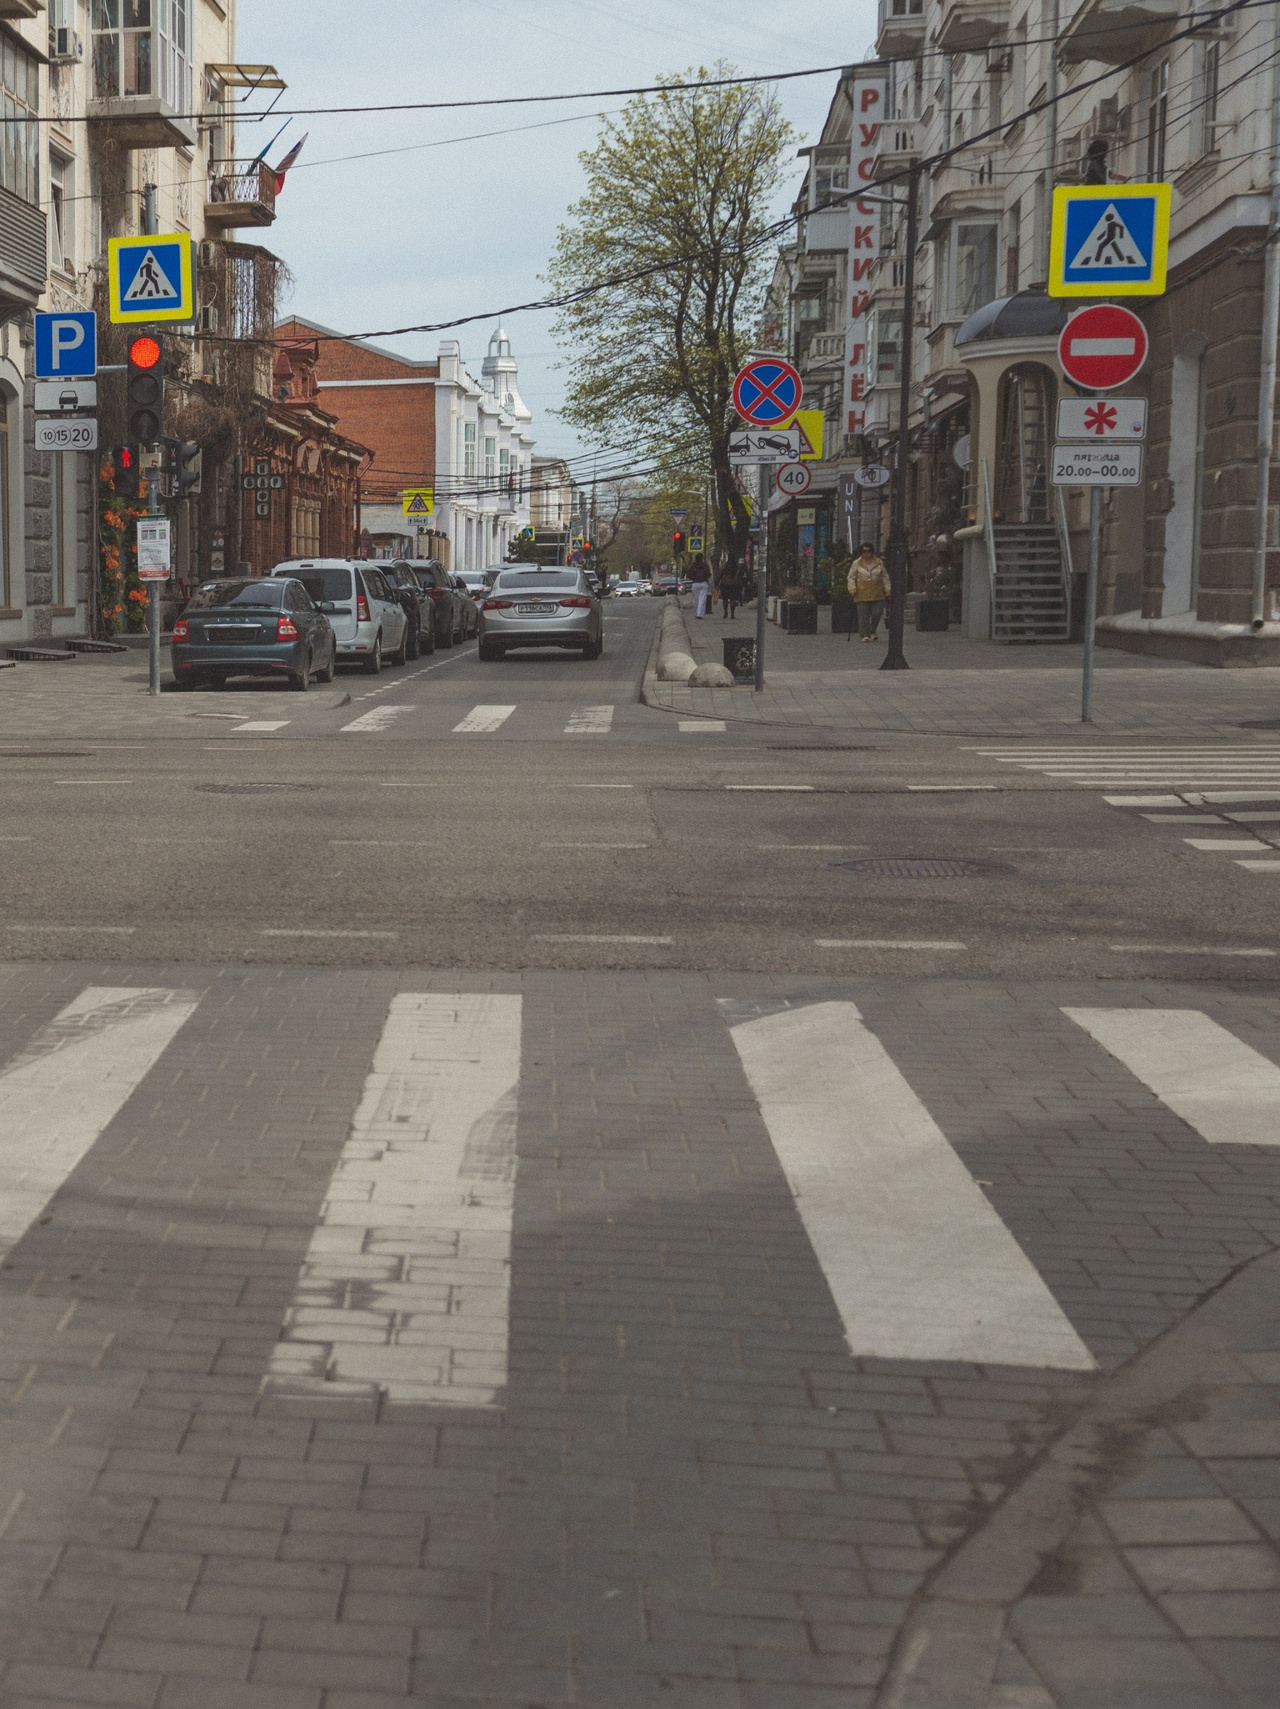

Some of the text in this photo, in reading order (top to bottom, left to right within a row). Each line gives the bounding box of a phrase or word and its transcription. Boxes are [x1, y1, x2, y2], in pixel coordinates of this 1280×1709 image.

[847, 88, 880, 433] РУССКИЙ ЛЁН
[51, 319, 85, 370] P
[43, 428, 90, 442] 10 15 20
[783, 471, 805, 485] 40
